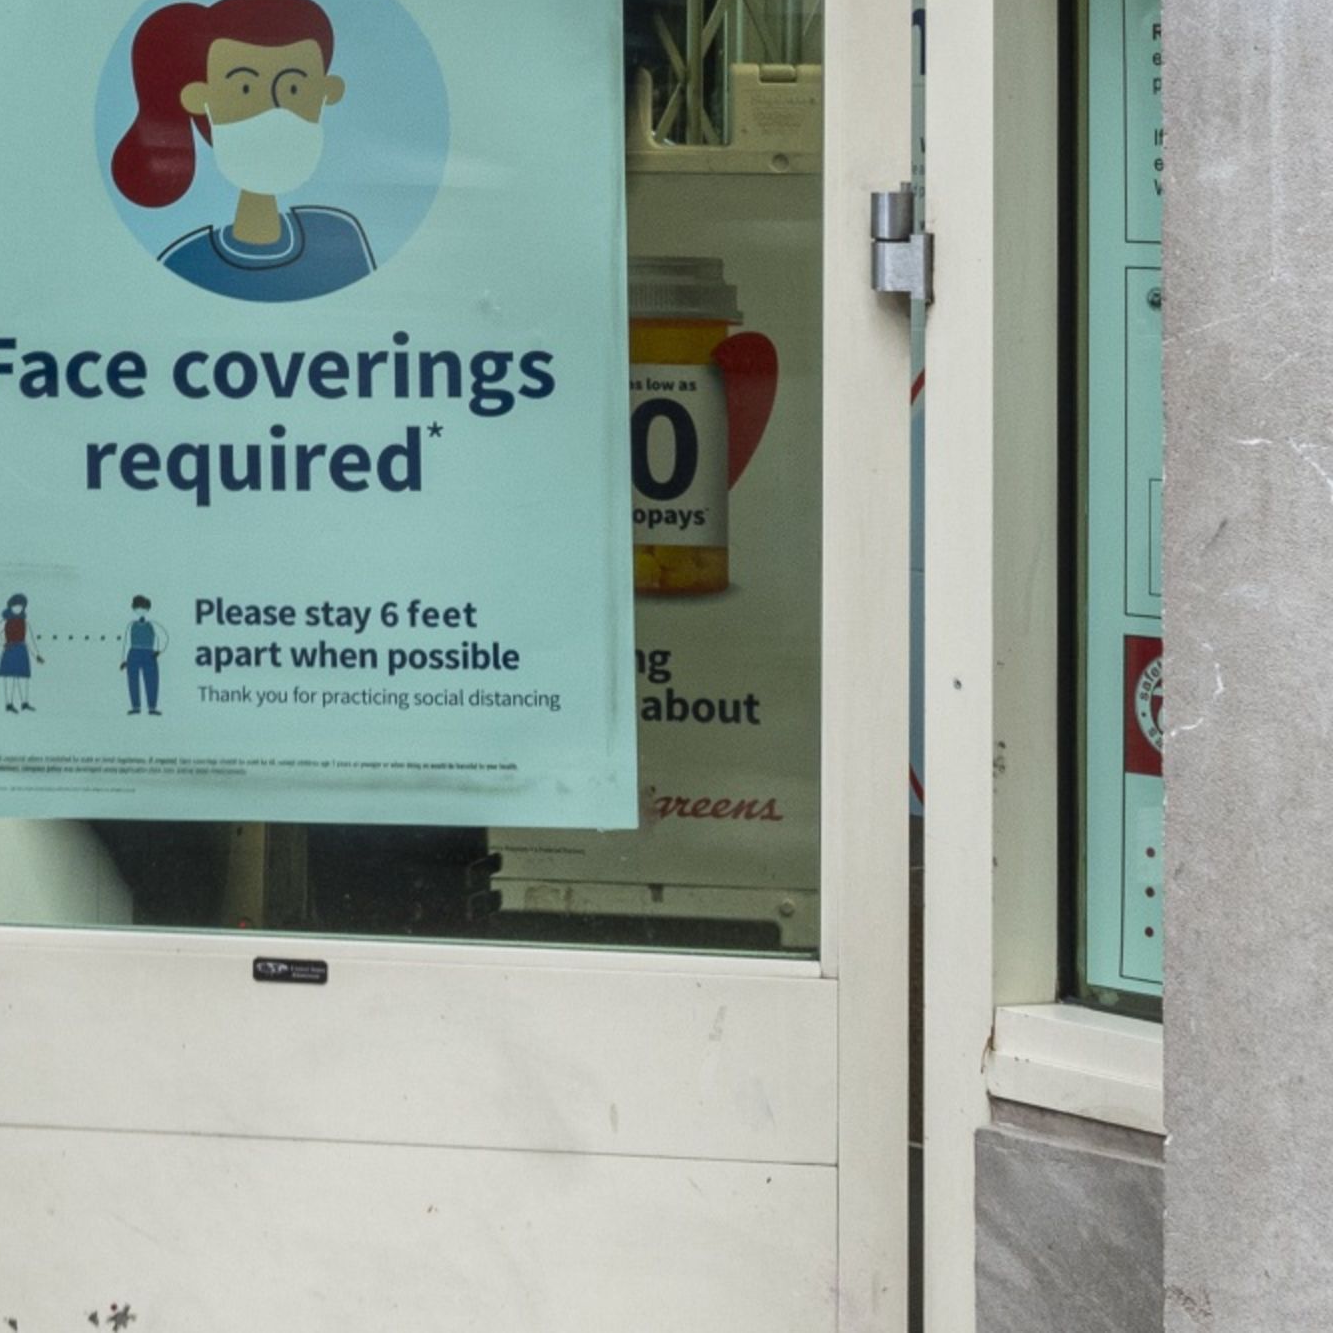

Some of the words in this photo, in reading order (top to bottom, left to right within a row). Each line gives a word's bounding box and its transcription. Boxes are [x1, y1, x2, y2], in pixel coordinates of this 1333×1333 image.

[172, 331, 556, 418] coverings
[646, 377, 675, 391] low
[678, 380, 697, 391] as
[195, 597, 296, 627] Please
[304, 601, 371, 634] stay
[380, 601, 400, 628] 6
[407, 599, 478, 628] feet
[195, 641, 282, 673] apart
[290, 640, 378, 669] when
[388, 641, 520, 676] possible
[198, 685, 252, 704] Thank
[256, 689, 289, 708] you
[293, 686, 317, 704] for
[321, 687, 410, 710] practicing
[413, 688, 464, 707] social
[468, 688, 562, 712] distancing
[640, 687, 761, 725] about
